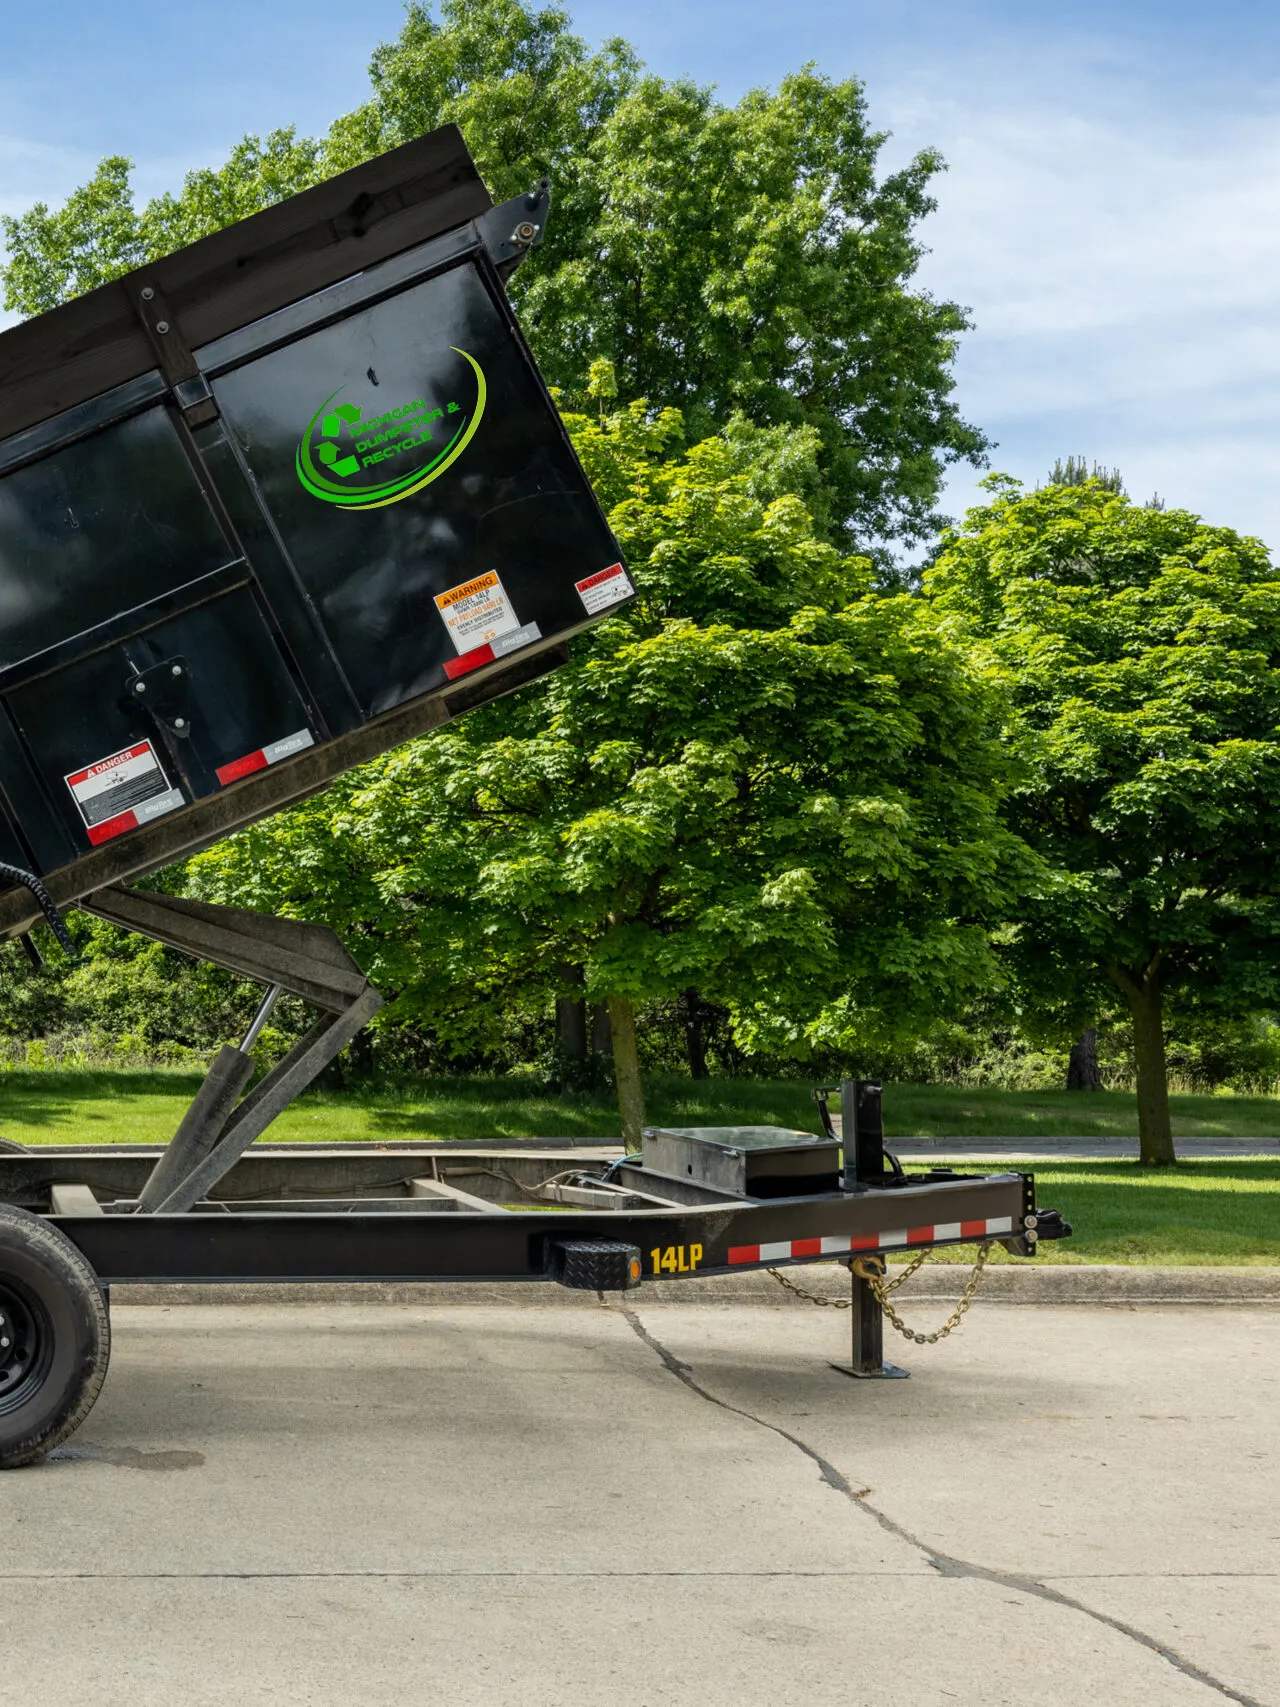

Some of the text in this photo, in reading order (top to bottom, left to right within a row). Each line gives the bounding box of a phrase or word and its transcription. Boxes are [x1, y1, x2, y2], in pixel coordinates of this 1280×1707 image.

[349, 397, 427, 438] MICHIGAN
[355, 401, 461, 453] DUMPSTER &
[361, 429, 433, 468] RECYCLE
[449, 576, 493, 601] WARNING
[452, 597, 474, 611] MODEL
[95, 751, 133, 774] DANGER
[650, 1243, 703, 1274] 14LP
